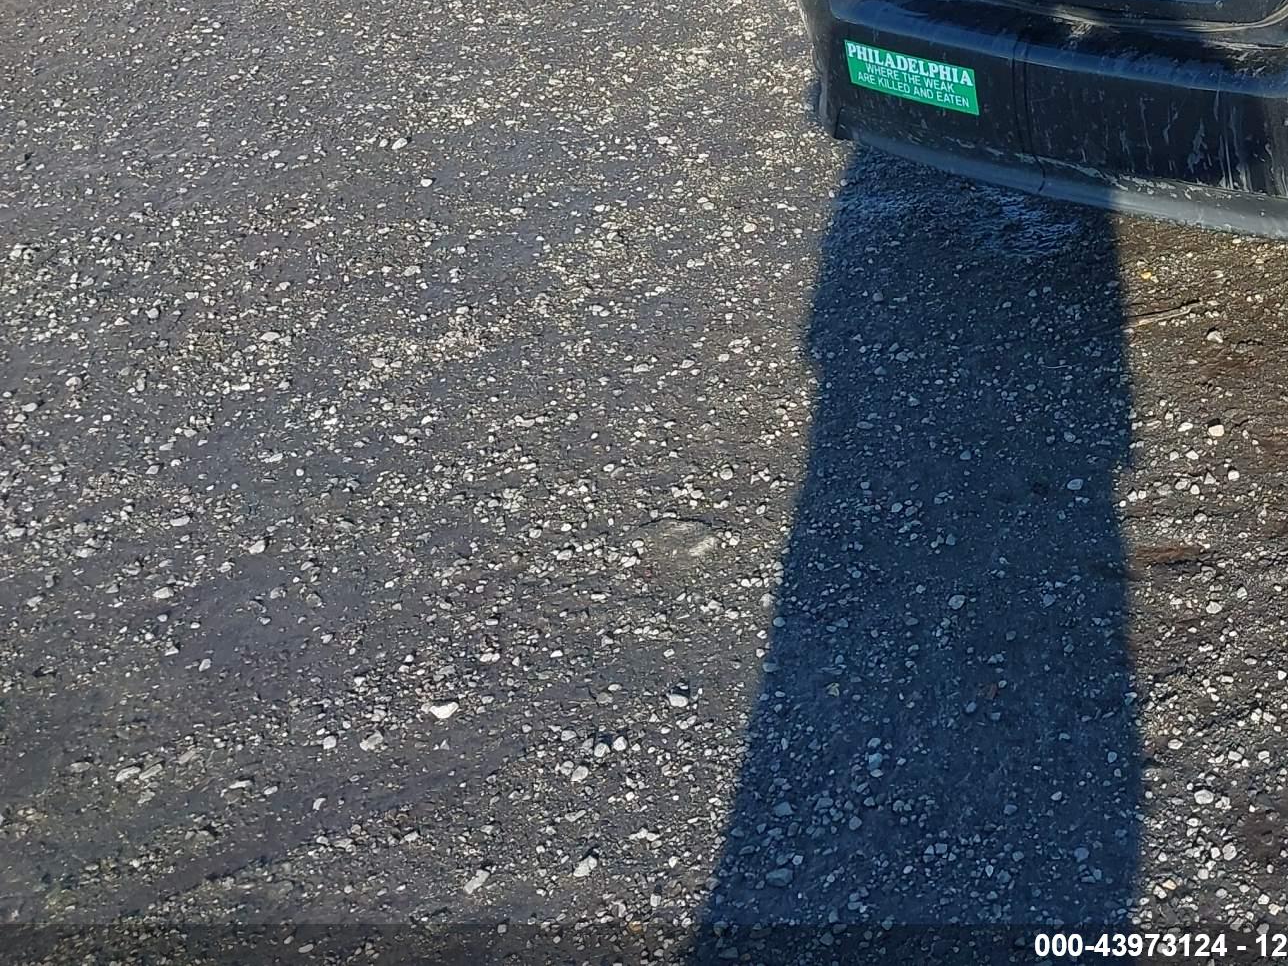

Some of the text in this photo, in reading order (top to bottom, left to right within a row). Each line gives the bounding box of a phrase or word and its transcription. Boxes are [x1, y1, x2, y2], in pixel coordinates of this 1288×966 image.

[846, 42, 974, 87] PHILADELPHIA
[866, 63, 955, 93] WHERE THE WEAK
[857, 72, 970, 108] ARE KILLED AND EATEN
